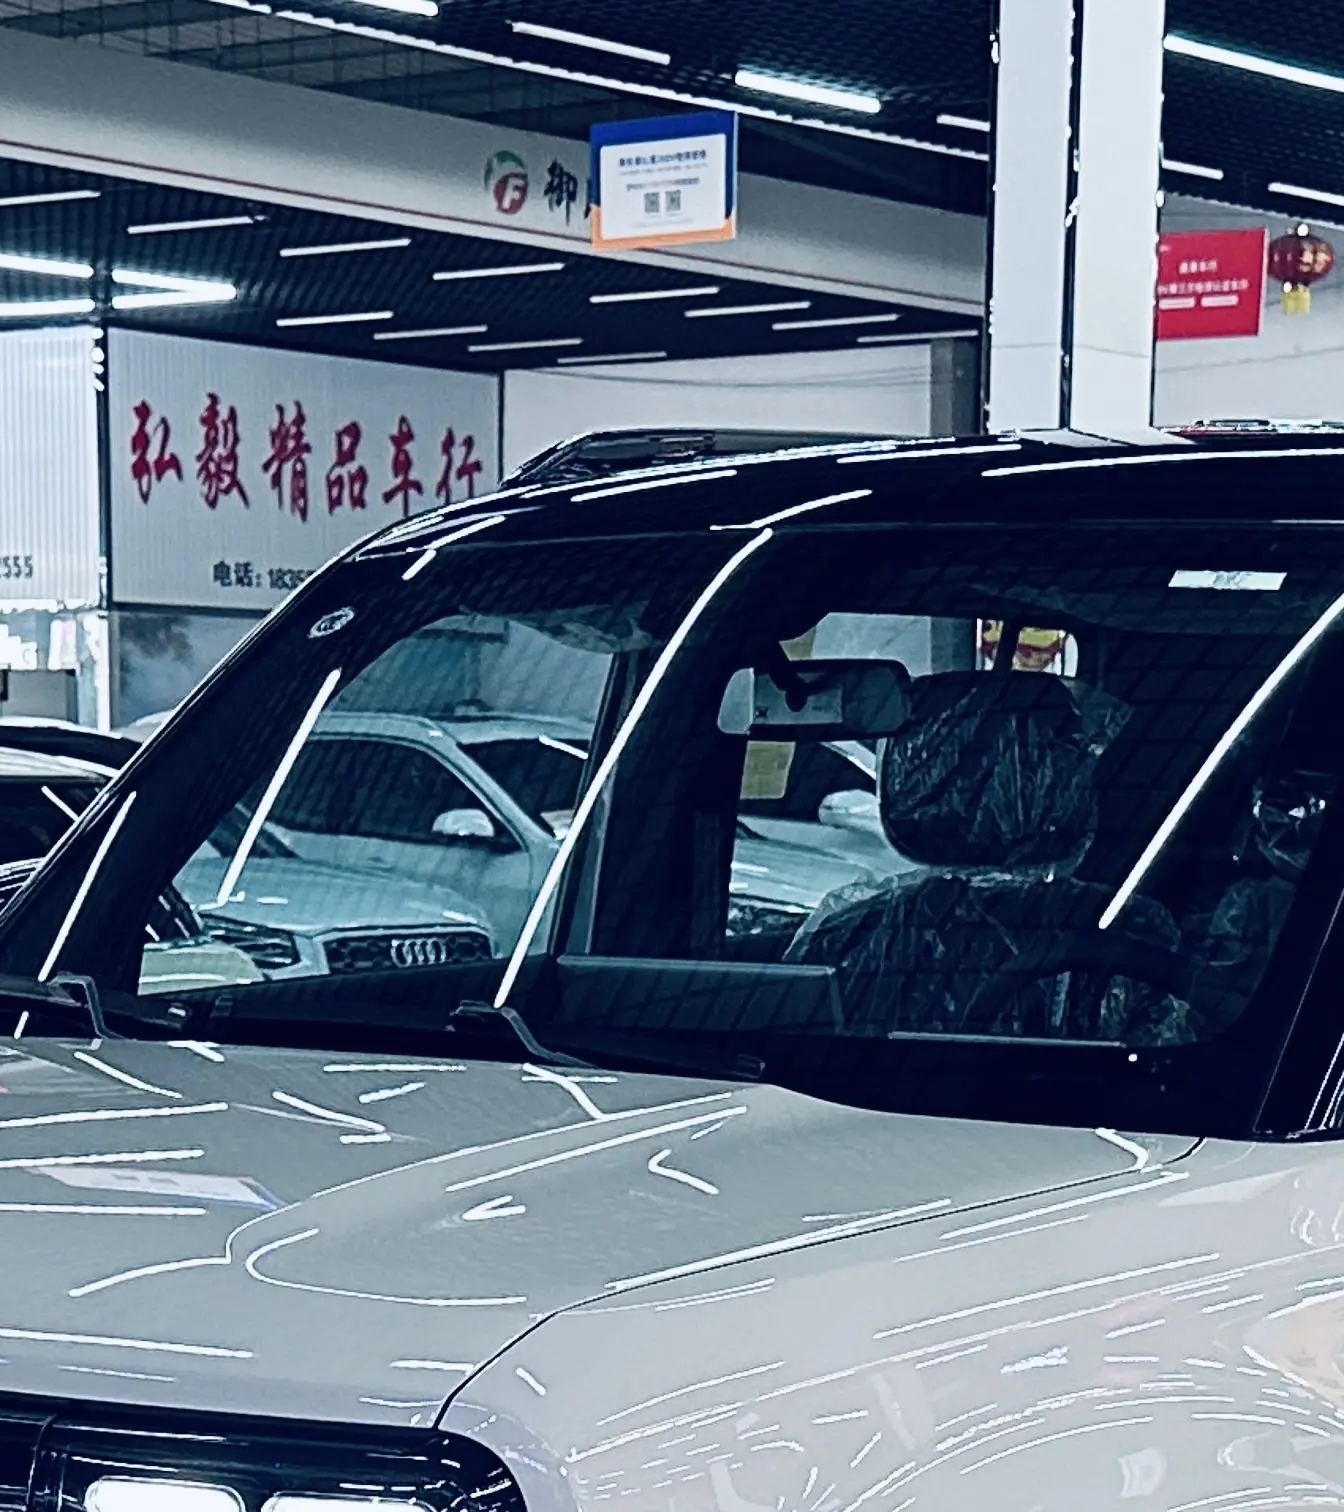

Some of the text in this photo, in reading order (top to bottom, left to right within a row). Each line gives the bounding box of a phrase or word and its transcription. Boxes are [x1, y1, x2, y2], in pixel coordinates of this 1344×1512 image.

[131, 392, 482, 524] 弘毅精品车行
